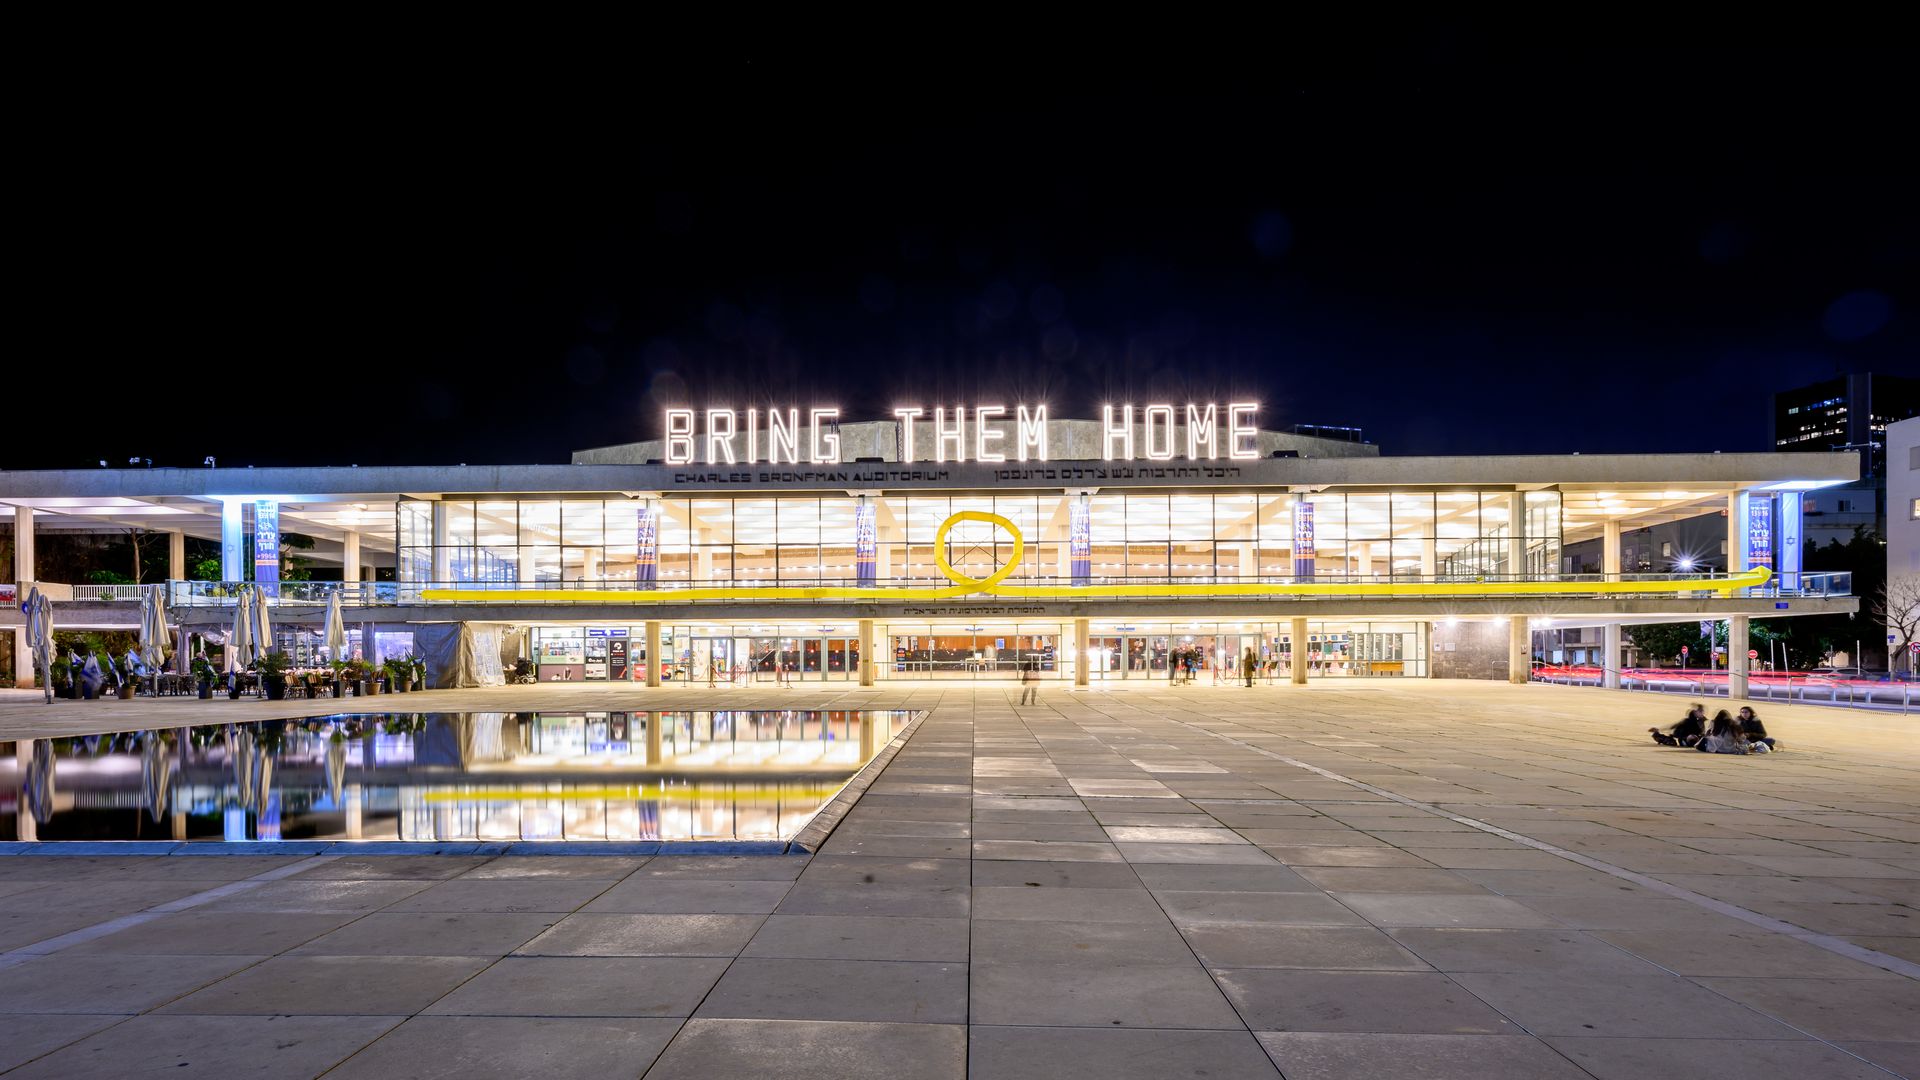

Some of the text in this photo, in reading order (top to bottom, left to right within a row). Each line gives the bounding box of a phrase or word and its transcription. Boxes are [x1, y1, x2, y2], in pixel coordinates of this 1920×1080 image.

[666, 403, 1259, 464] BRING THEM HOME
[674, 471, 949, 484] CHARLES BRONFMAN AUDITORIUM
[993, 469, 1057, 483] ברונפמן
[1138, 467, 1199, 479] התרבות
[1202, 466, 1240, 478] היכל
